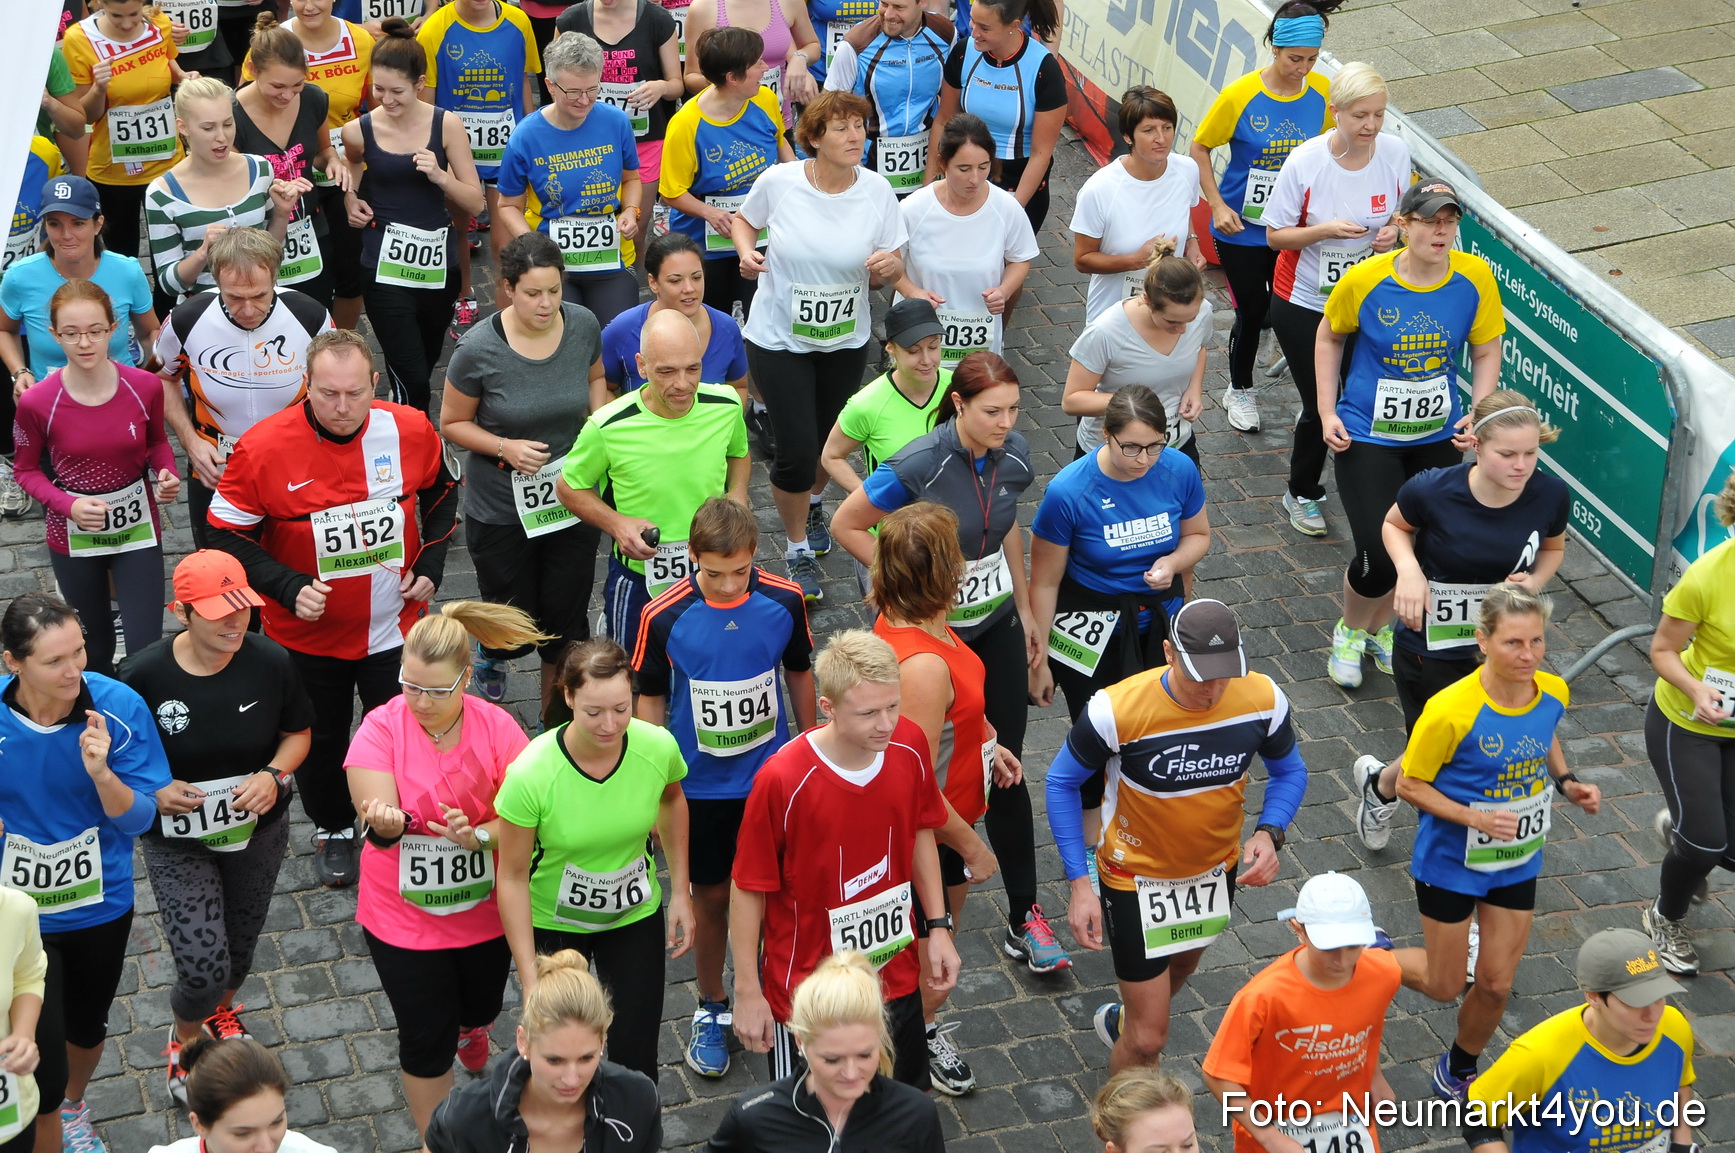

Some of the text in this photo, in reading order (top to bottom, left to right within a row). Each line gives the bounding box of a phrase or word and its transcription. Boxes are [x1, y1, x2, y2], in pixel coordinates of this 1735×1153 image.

[184, 36, 197, 46] illi
[138, 47, 166, 67] BÖGL
[324, 63, 360, 81] BÖGL
[109, 105, 164, 121] PARTL Neumarkt
[116, 113, 170, 142] 5131
[125, 143, 168, 156] Katharina
[473, 152, 497, 160] Laura
[533, 144, 614, 170] 10. NEUMARKTER
[549, 156, 604, 174] STADTLAUF
[901, 174, 920, 186] Sven
[581, 193, 617, 207] 20.09.2009
[551, 219, 574, 228] PARTL
[558, 225, 613, 249] 5529
[389, 238, 443, 267] 5005
[1321, 251, 1345, 259] PARTL
[278, 265, 302, 277] elina
[400, 268, 426, 281] Linda
[794, 288, 852, 298] PARTL Neumarkt
[799, 297, 855, 324] 5074
[950, 314, 983, 323] Neumarkt
[809, 325, 841, 338] Claudia
[1500, 336, 1580, 421] cherheit
[1379, 385, 1439, 398] PARTL Neumarkt
[1383, 394, 1445, 420] 5182
[1388, 421, 1433, 434] Michaela
[514, 473, 540, 484] PARTL
[107, 492, 135, 506] umarkt
[314, 505, 385, 527] PARTL Neumarkt
[1572, 500, 1603, 539] 6352
[324, 516, 395, 554] 5152
[1103, 511, 1172, 541] HUBER
[92, 533, 131, 546] Natalie
[1120, 527, 1170, 545] TECHNOLOGY
[333, 550, 390, 570] Alexander
[1431, 587, 1460, 596] PARTL
[963, 602, 993, 619] Carola
[1436, 598, 1484, 623] 51
[1054, 610, 1105, 646] 228
[692, 682, 763, 699] PARTL Neumarkt
[701, 691, 771, 730] 5194
[715, 732, 758, 749] Thomas
[1167, 752, 1247, 774] Fischer
[1175, 766, 1240, 782] AUTOMOBILE
[7, 840, 83, 861] PARTL Neumarkt
[402, 841, 433, 852] PARTL
[1495, 847, 1525, 860] Doris
[11, 849, 93, 889] 5026
[410, 849, 486, 886] 5180
[565, 868, 636, 887] PARTL Neumarkt
[857, 869, 879, 889] DEHN
[1137, 879, 1166, 890] PARTL
[36, 890, 78, 905] ristina
[425, 889, 471, 905] Daniela
[569, 877, 644, 911] 5516
[1148, 881, 1219, 924] 5147
[832, 896, 899, 928] PARTL Neumarkt
[840, 905, 904, 952] 5006
[1170, 924, 1203, 941] Bernd
[871, 944, 900, 965] inand
[1293, 1025, 1373, 1052] Fischer
